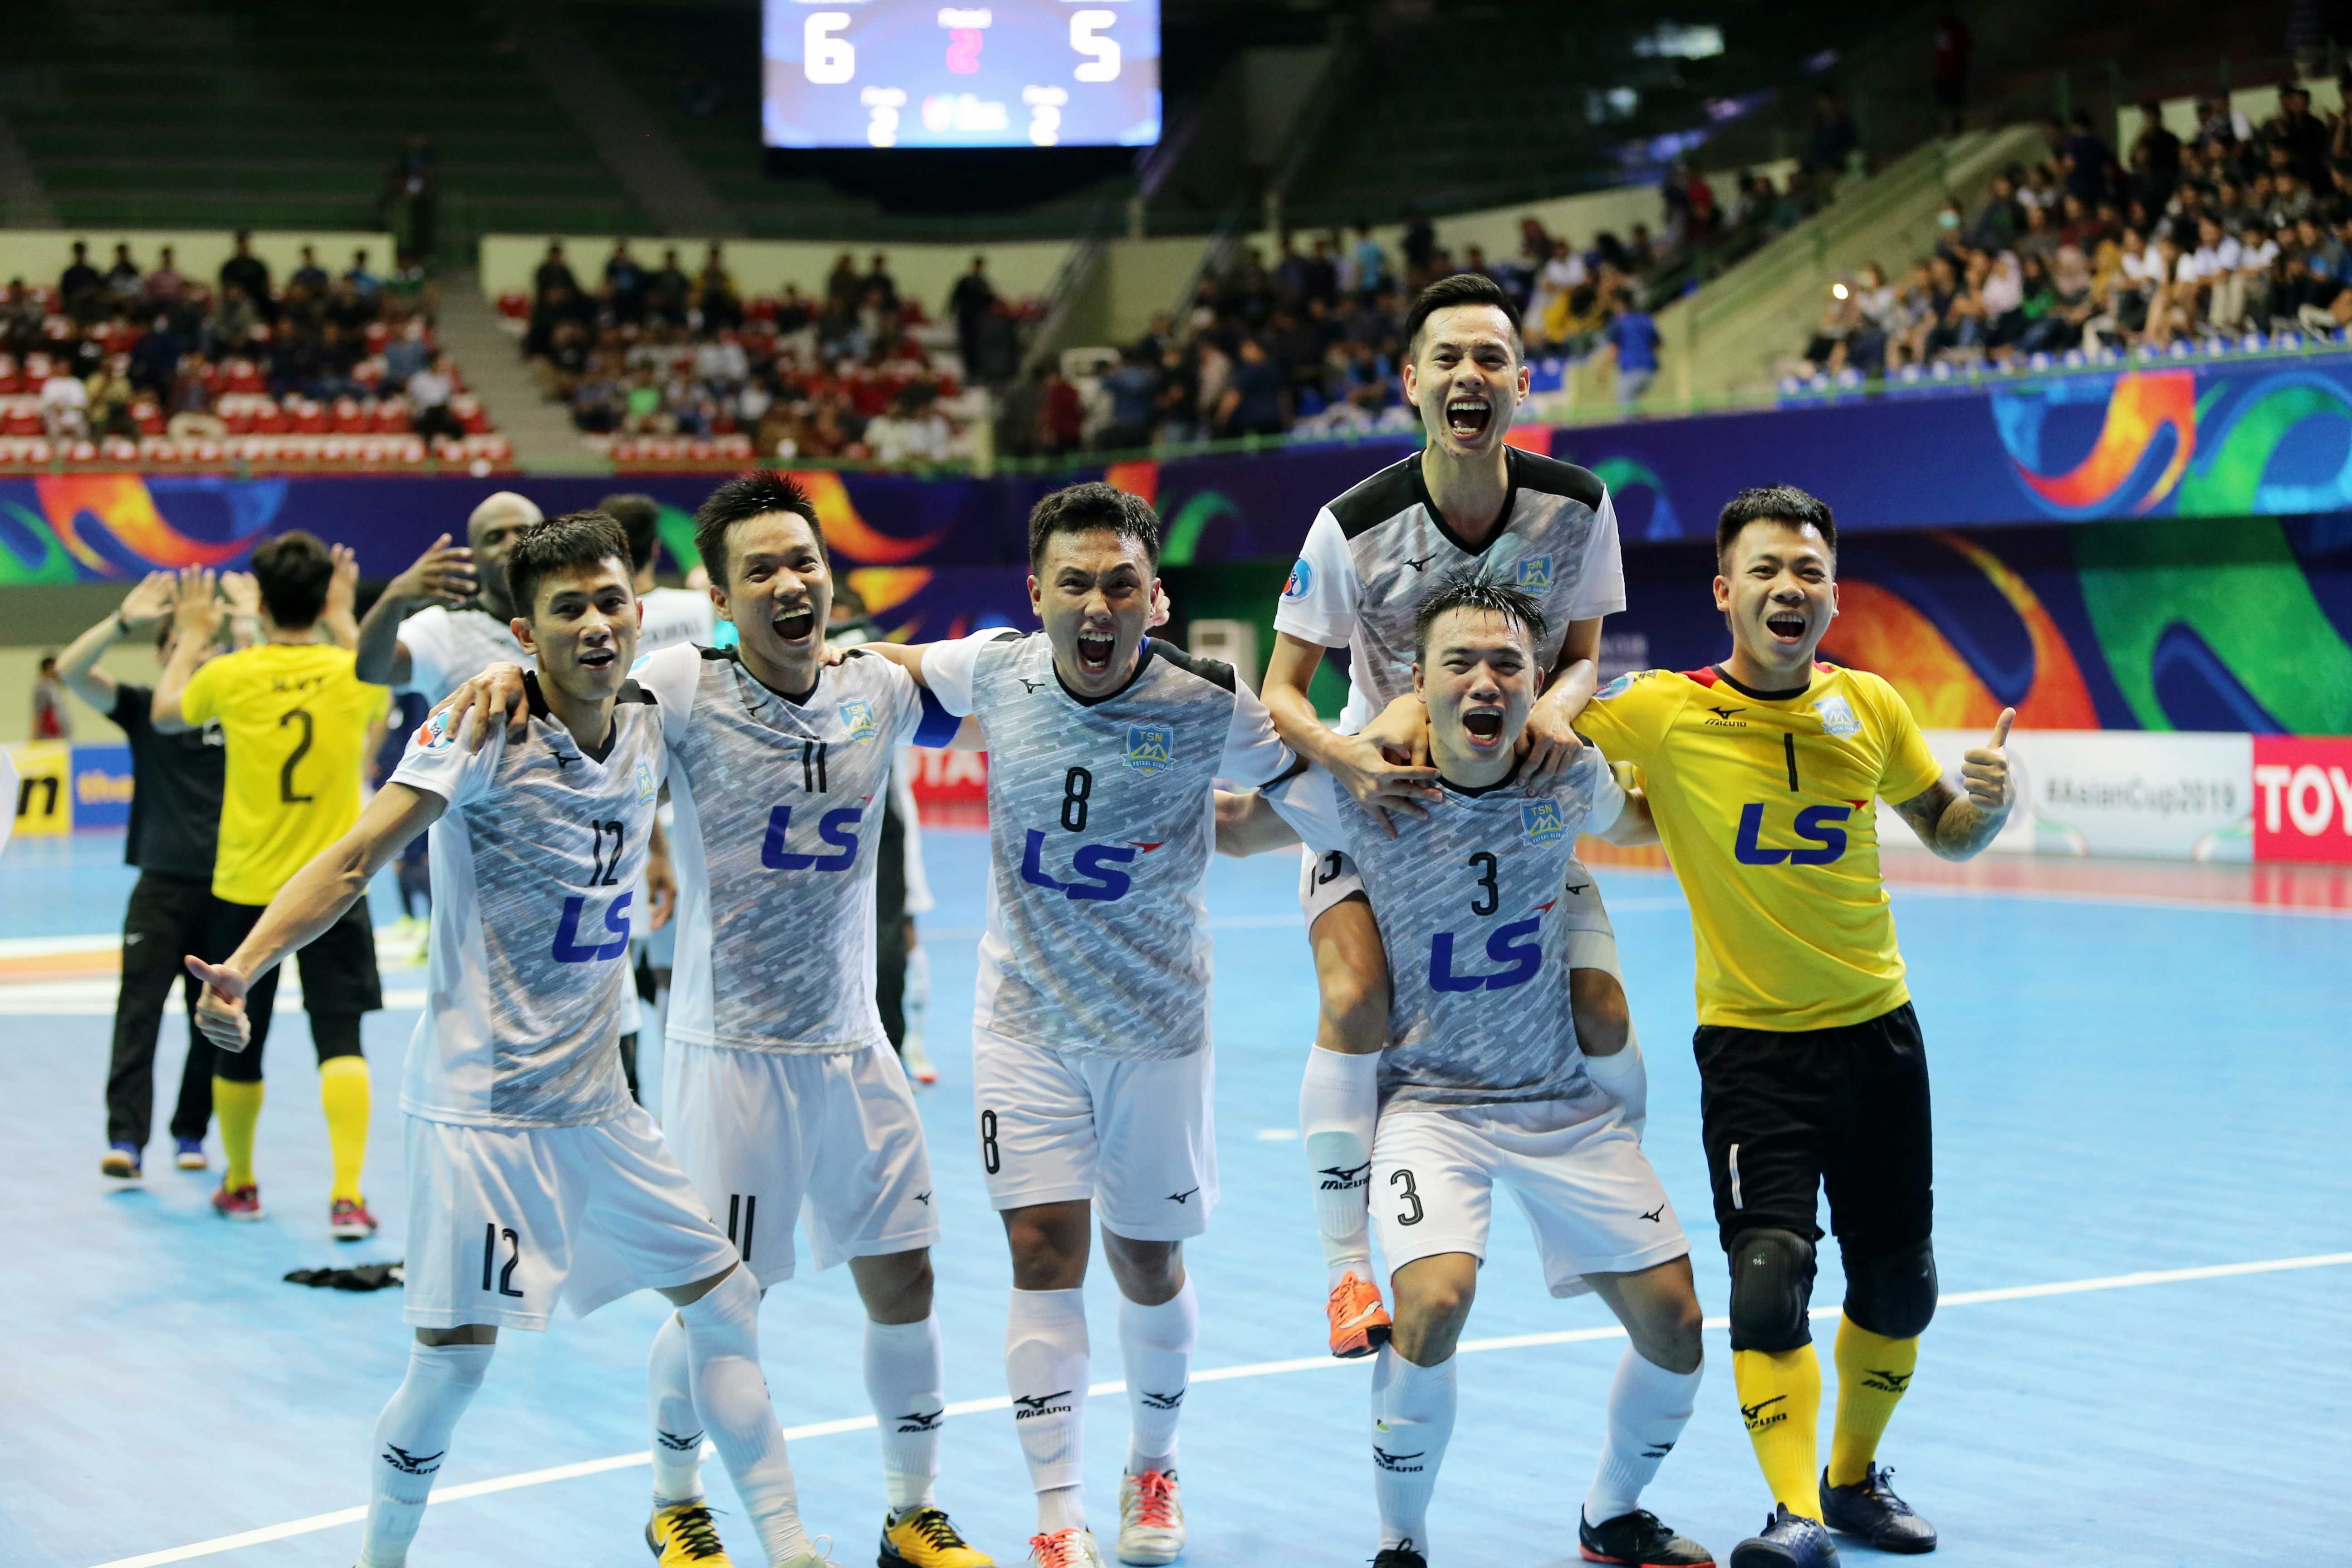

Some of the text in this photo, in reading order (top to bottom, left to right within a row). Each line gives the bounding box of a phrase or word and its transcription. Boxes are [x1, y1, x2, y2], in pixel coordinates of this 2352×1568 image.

[804, 12, 855, 84] 6
[946, 28, 984, 74] 2
[1070, 10, 1121, 82] 5
[280, 710, 314, 802] 2
[799, 736, 827, 793] 11
[1139, 731, 1163, 742] TSN
[1784, 733, 1799, 792] 1
[1061, 767, 1092, 833] 8
[1530, 804, 1553, 816] TSN
[590, 820, 624, 886] 12
[761, 806, 863, 871] LS
[1021, 828, 1136, 902] LS
[1735, 804, 1851, 865] LS
[1469, 852, 1498, 916] 3
[552, 891, 633, 963] LS
[1429, 916, 1542, 992] LS
[981, 1110, 1000, 1174] 8
[728, 1194, 756, 1261] 11
[1390, 1169, 1424, 1226] 3
[482, 1223, 524, 1298] 12
